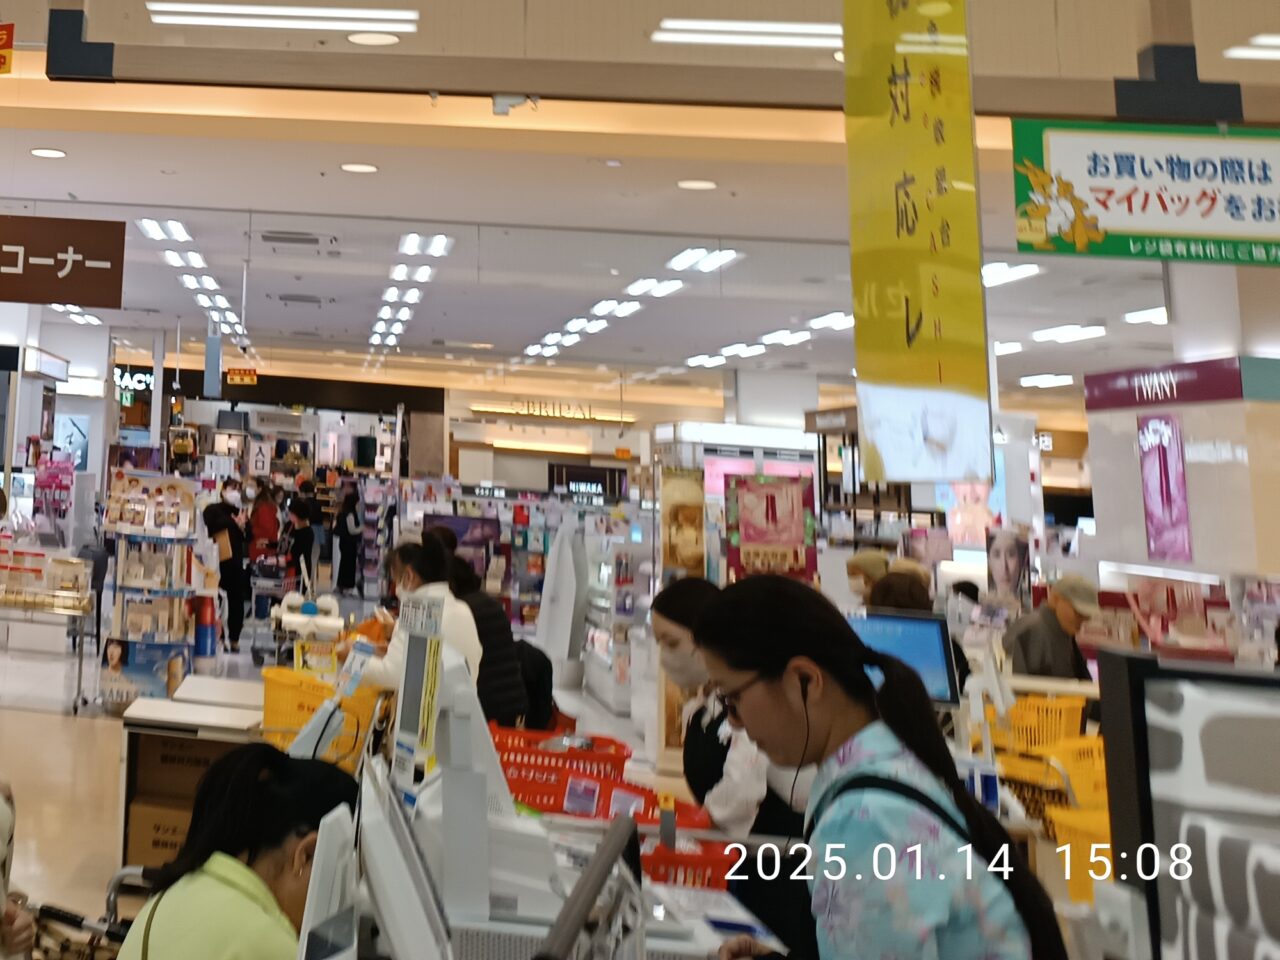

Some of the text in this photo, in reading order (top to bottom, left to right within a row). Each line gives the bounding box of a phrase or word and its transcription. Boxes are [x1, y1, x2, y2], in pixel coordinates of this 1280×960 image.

[1087, 151, 1272, 185] お買い物の際は
[1089, 186, 1280, 222] マイバッグをお
[255, 445, 265, 471] 入口
